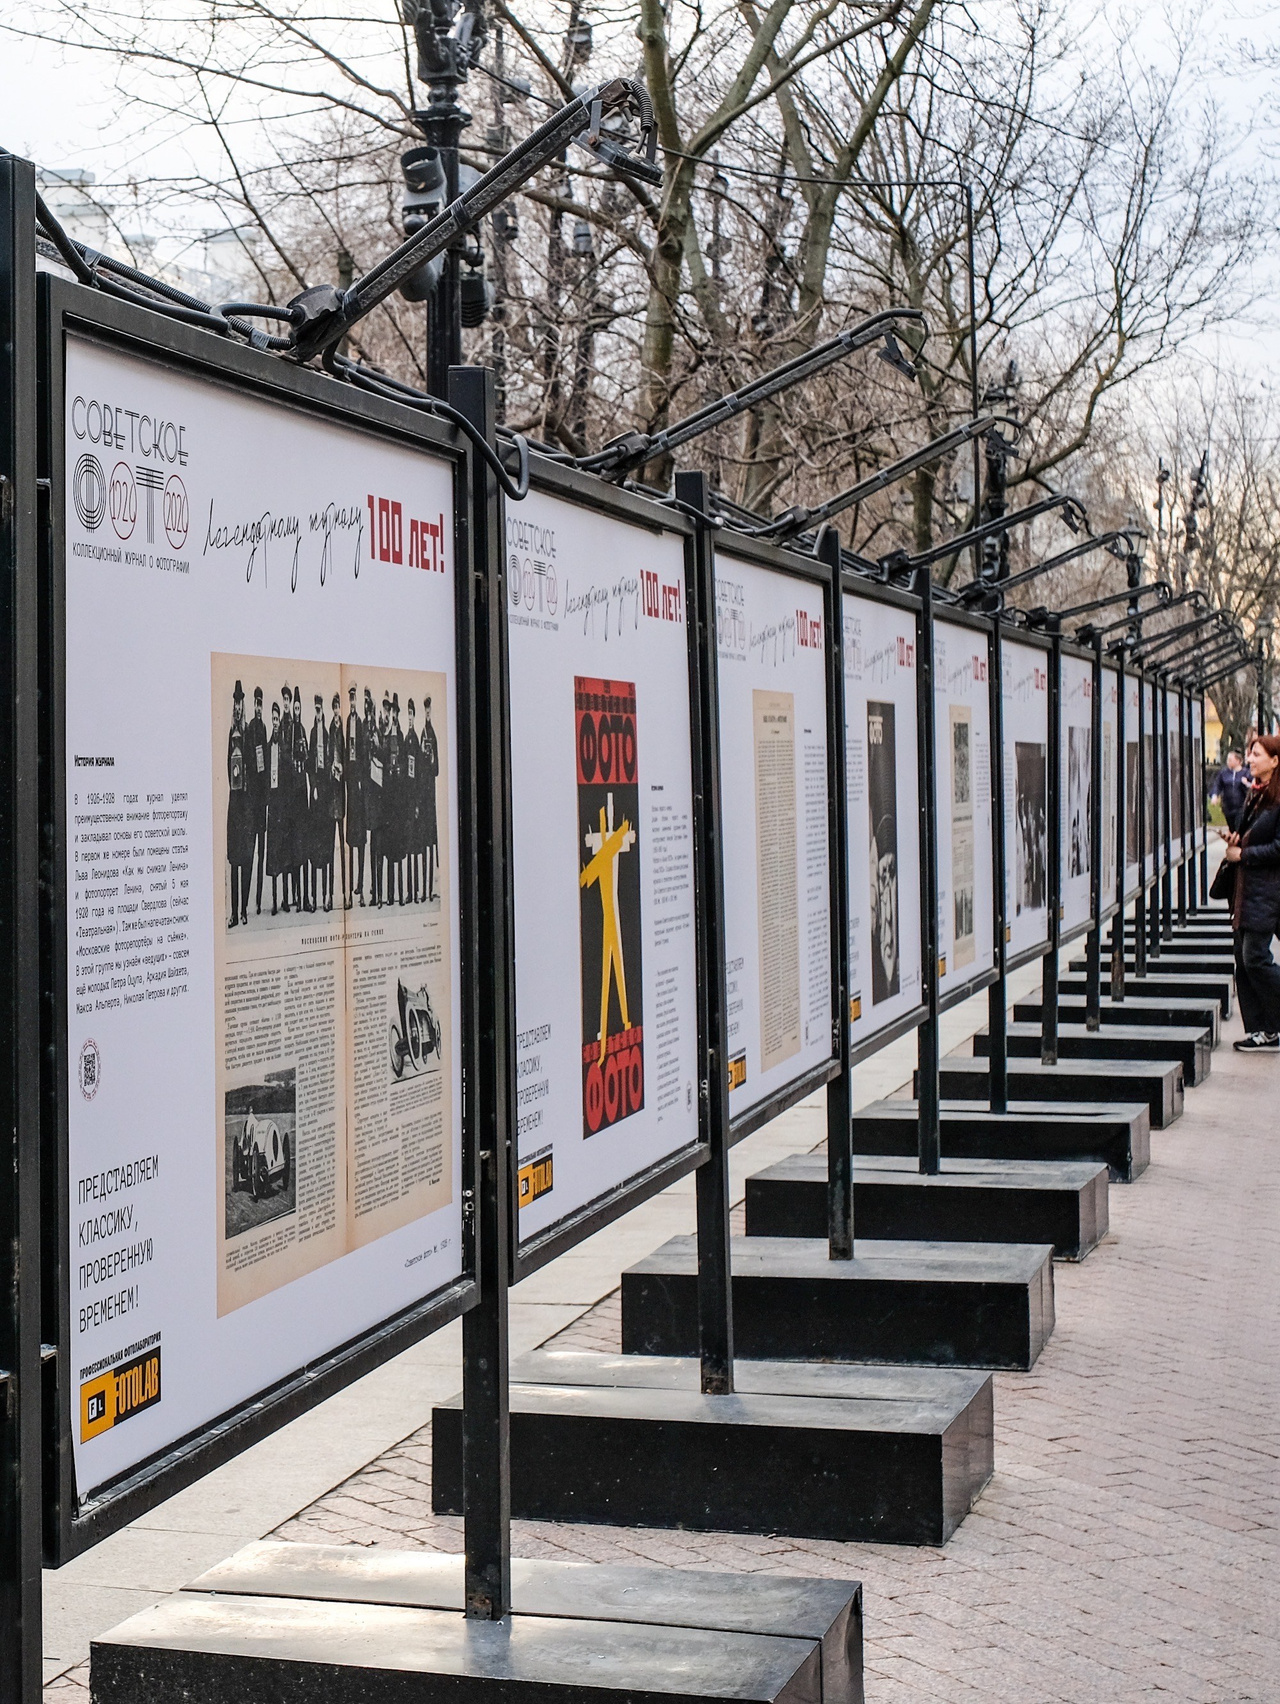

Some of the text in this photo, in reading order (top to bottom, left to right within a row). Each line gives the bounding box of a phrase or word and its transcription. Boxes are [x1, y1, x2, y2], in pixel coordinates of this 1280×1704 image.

[72, 395, 189, 466] СОВЕТСКОЕ
[72, 541, 190, 574] КОЛЛЕКЦИОННЫЙ ЖУРНАЛ О ФОТОГРАФИИ
[368, 494, 403, 565] 100
[409, 513, 445, 573] ЛЕТ!
[640, 569, 660, 618] 100
[662, 579, 682, 623] ЛЕТ!
[580, 712, 636, 782] ФОТО
[75, 794, 78, 805] В
[87, 793, 115, 804] 1926-1928
[123, 795, 138, 804] годах
[147, 794, 163, 805] журнал
[586, 1045, 642, 1132] ФОТО
[79, 1155, 158, 1204] ПРЕДСТАВЛЯЕМ
[79, 1204, 138, 1247] КЛАССИКУ,
[80, 1238, 153, 1290] ПРОВЕРЕННУЮ
[80, 1285, 138, 1333] ВРЕМЕНЕМ!
[114, 1356, 158, 1418] FOTOLAB
